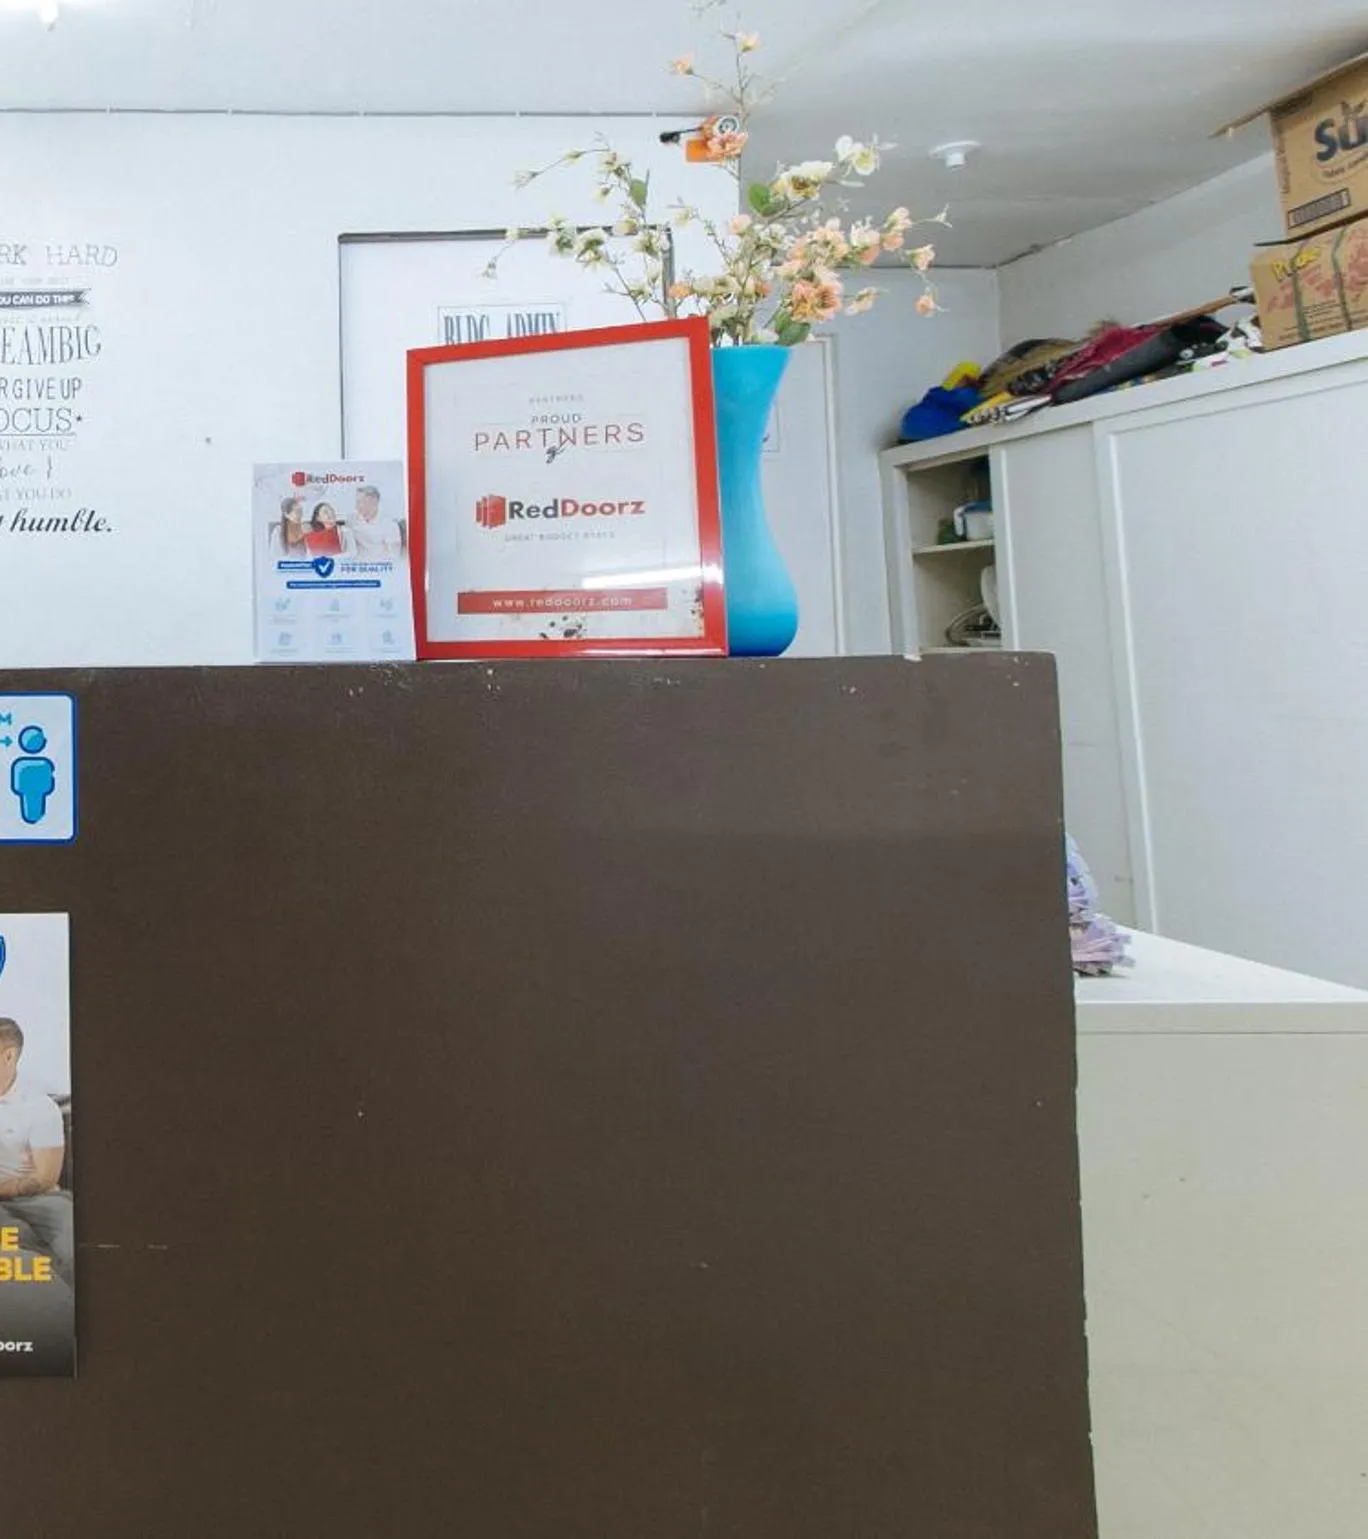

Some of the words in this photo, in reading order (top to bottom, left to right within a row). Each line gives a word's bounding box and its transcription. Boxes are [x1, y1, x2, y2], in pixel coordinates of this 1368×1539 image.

[45, 244, 119, 267] HARD
[12, 294, 34, 305] CAN
[35, 294, 51, 305] DO
[12, 378, 56, 400] GIVE
[60, 376, 82, 400] UP
[531, 413, 583, 425] PROUD
[474, 421, 645, 451] PARTNERS
[306, 473, 366, 485] RedDoorz
[9, 507, 113, 532] humble.
[508, 498, 646, 520] RedDoorz
